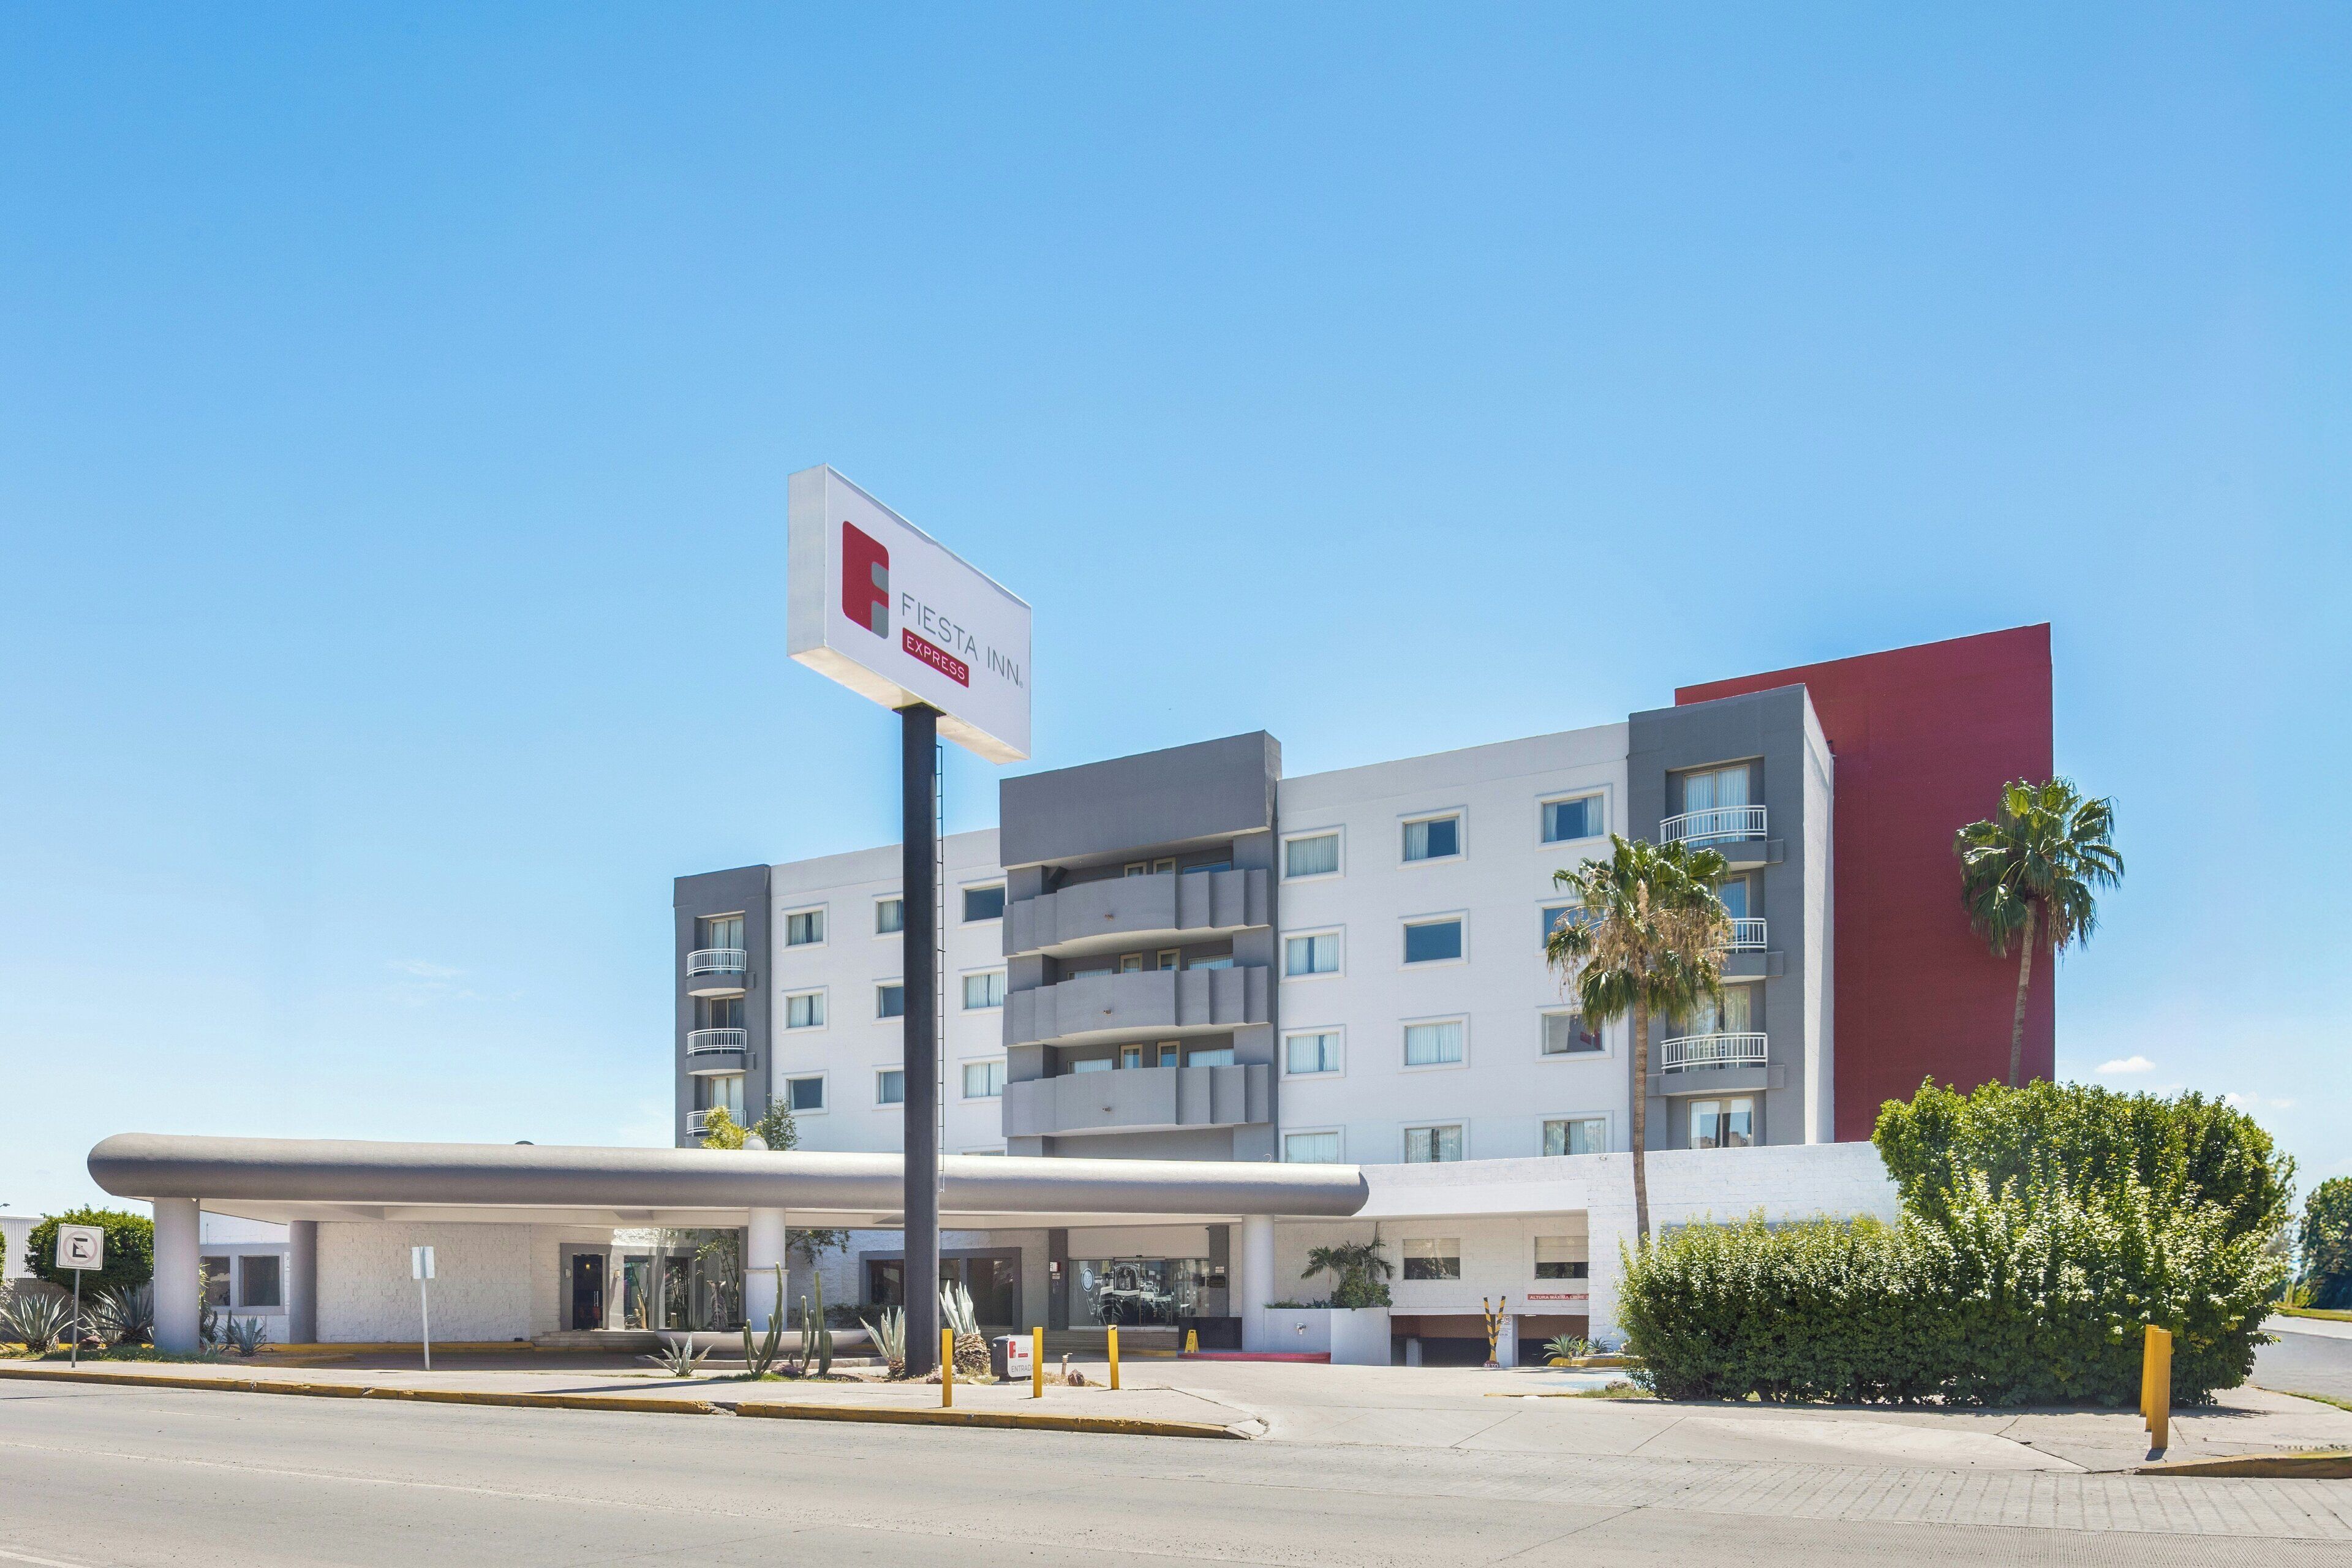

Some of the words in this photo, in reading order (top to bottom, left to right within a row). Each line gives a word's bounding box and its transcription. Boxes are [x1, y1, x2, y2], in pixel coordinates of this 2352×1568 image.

[902, 592, 978, 662] FIESTA
[987, 646, 1019, 686] INN
[907, 635, 965, 680] EXPRESS
